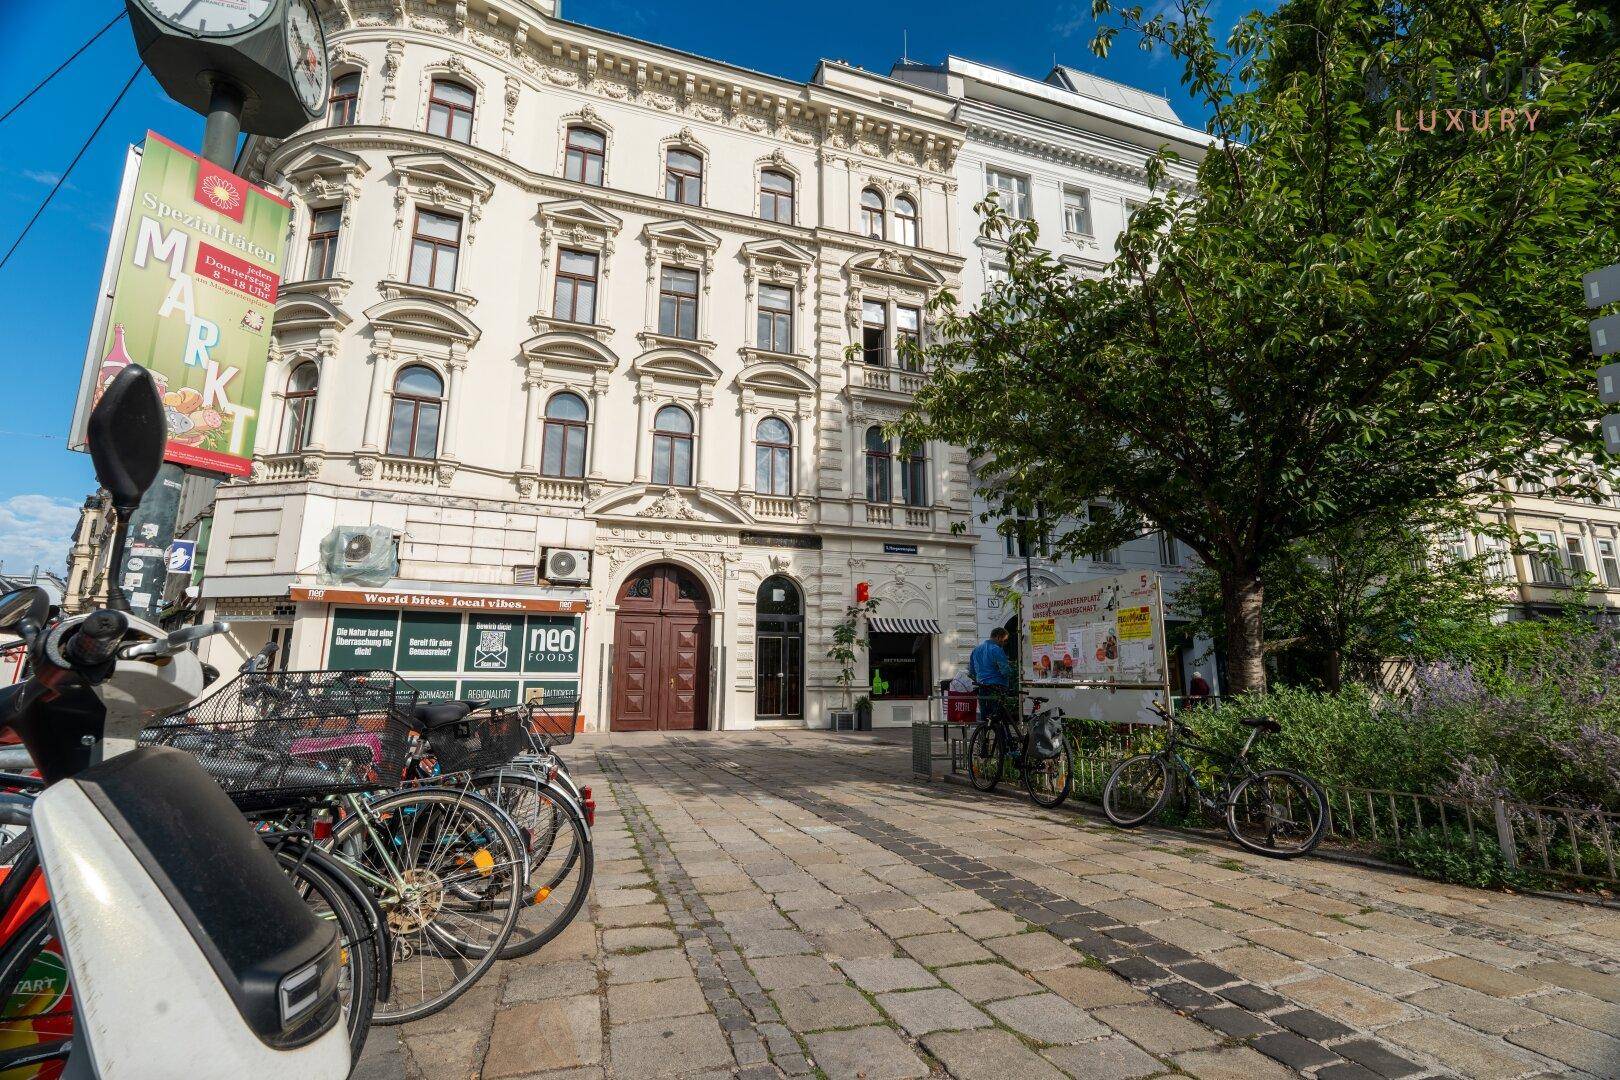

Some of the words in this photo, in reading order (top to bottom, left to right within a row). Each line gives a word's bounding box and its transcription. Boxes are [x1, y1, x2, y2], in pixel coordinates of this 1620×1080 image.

[143, 192, 276, 265] Spezialitäten
[205, 255, 272, 292] Donnerstag
[247, 265, 272, 281] jeden
[213, 270, 221, 279] 8
[233, 279, 246, 290] 18
[249, 285, 270, 299] Uhr
[364, 593, 408, 604] World
[412, 595, 449, 606] bites.
[453, 598, 485, 607] local
[488, 600, 527, 609] vibes.
[1051, 604, 1098, 617] NACHBARSCHAFT
[336, 627, 348, 636] Die
[349, 628, 367, 637] Natur
[367, 629, 379, 637] hat
[379, 629, 394, 637] eine
[336, 636, 382, 647] Überraschung
[382, 638, 392, 646] für
[409, 638, 428, 647] Bereit
[429, 638, 439, 647] für
[439, 639, 453, 647] eine
[530, 628, 576, 653] neo
[354, 647, 372, 656] dich!
[409, 648, 451, 656] Genussreise?
[528, 653, 575, 662] FOODS
[468, 688, 512, 699] REGIONALITÄT
